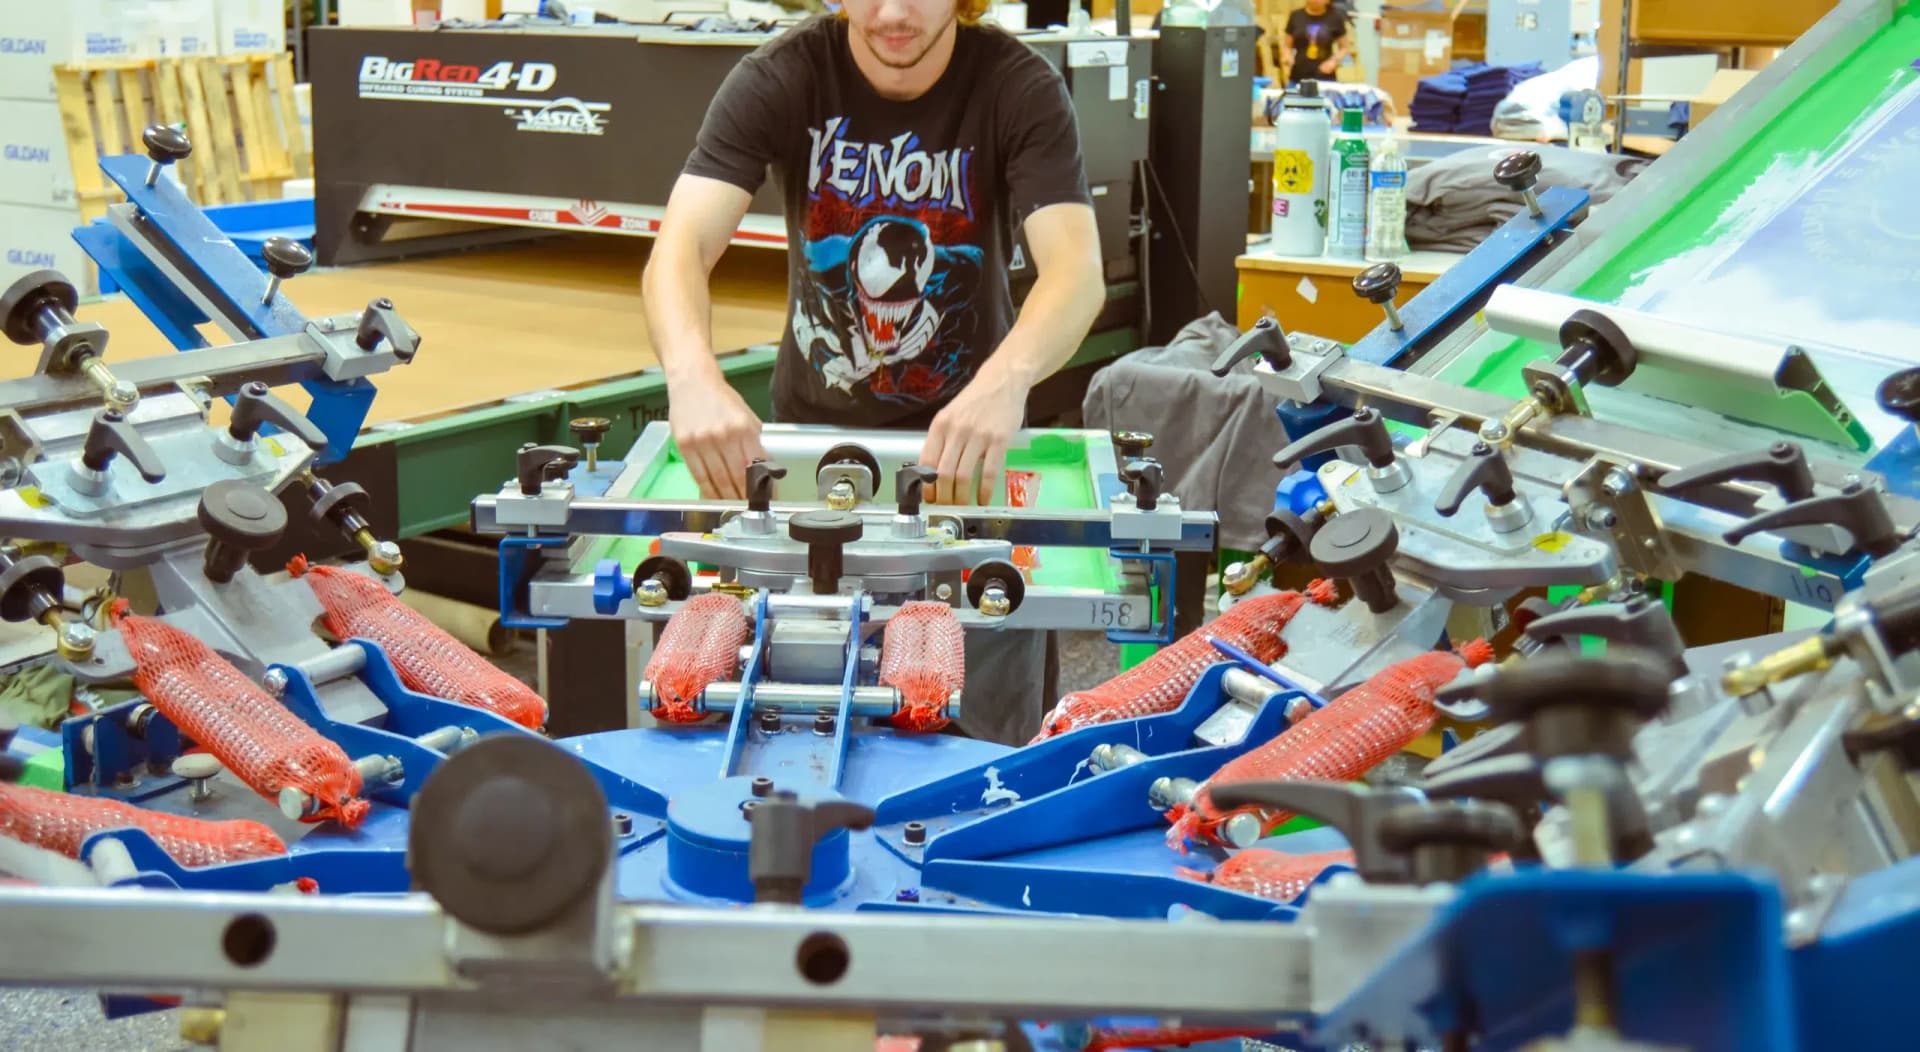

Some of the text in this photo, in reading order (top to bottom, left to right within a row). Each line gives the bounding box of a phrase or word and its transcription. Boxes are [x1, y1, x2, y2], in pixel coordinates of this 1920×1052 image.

[4, 144, 50, 162] GILDAN
[808, 116, 966, 210] VENOM
[7, 249, 55, 267] GILDAN
[1089, 601, 1133, 627] 158
